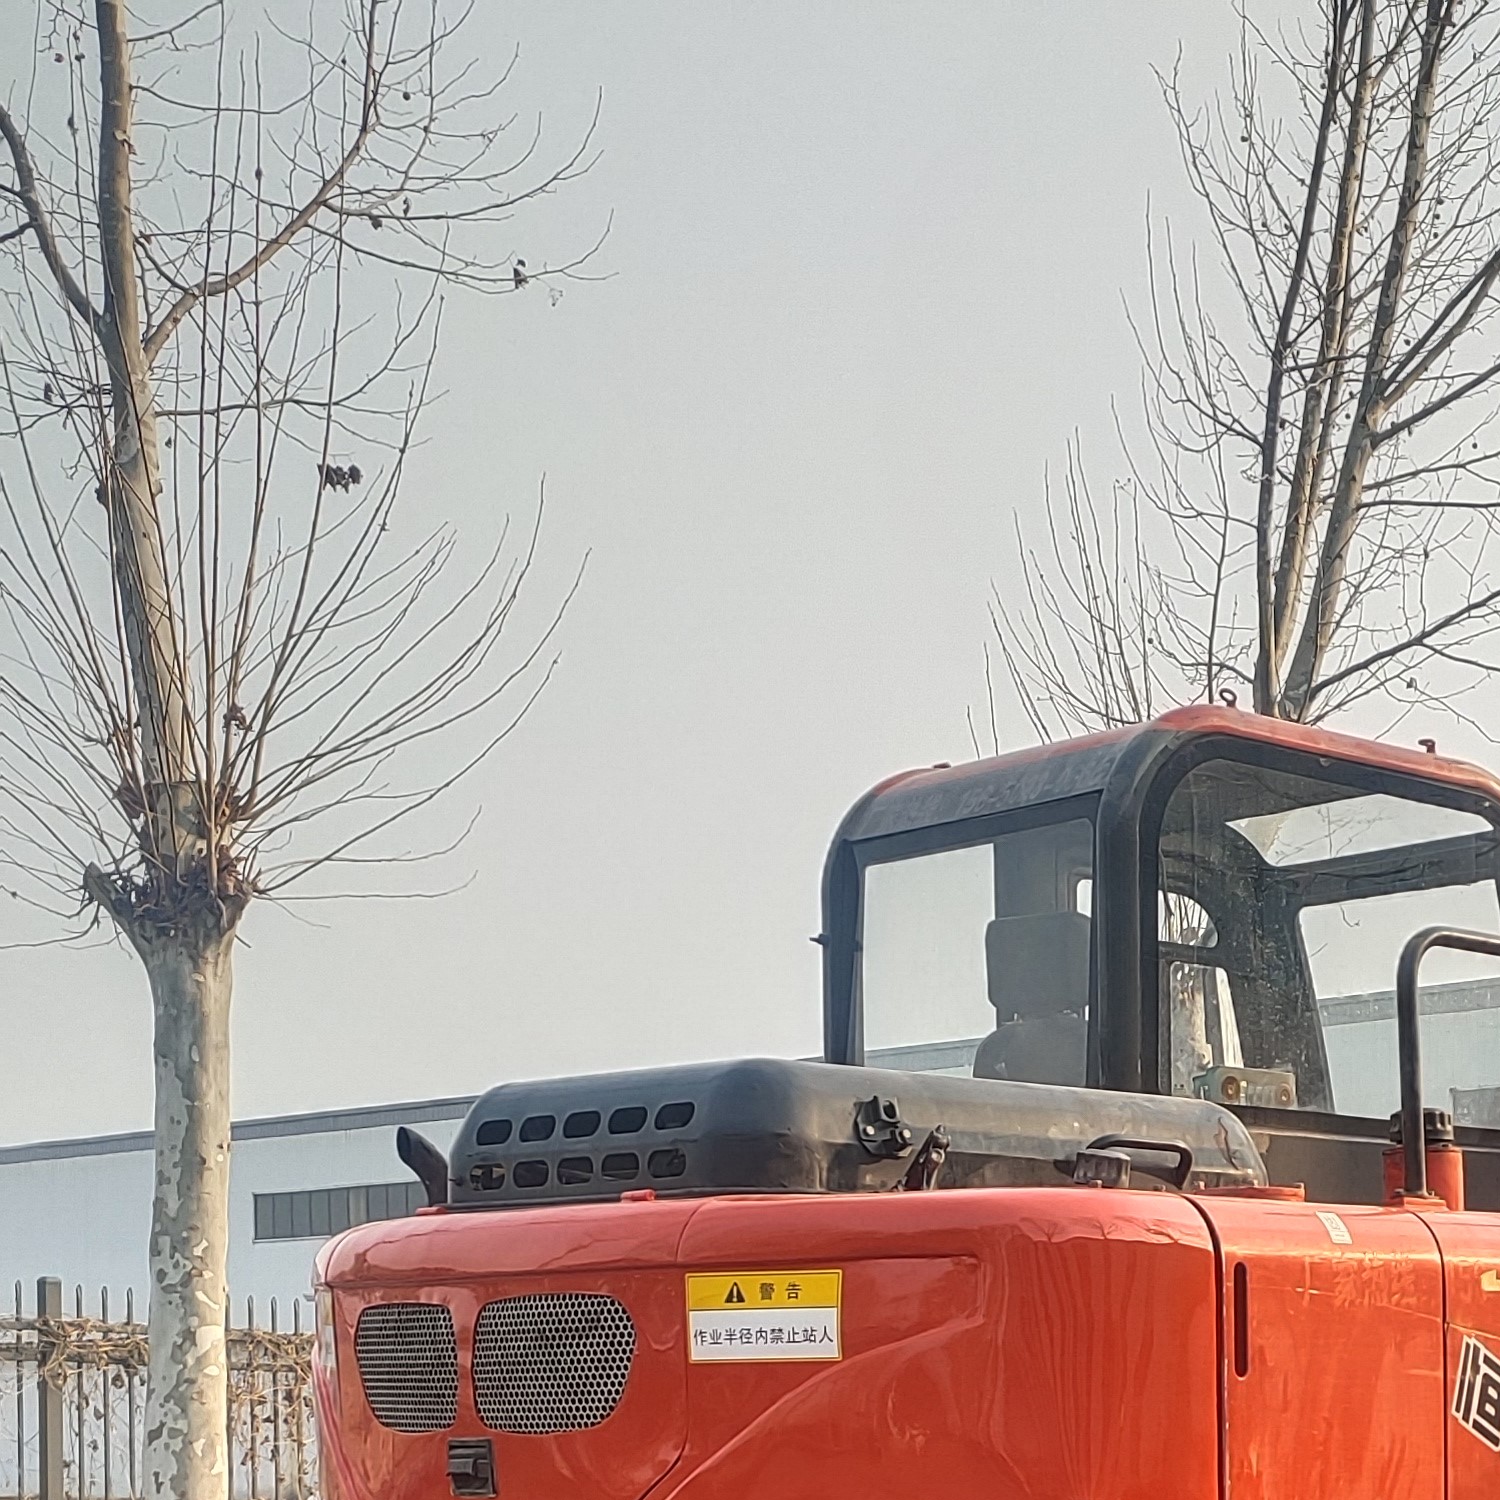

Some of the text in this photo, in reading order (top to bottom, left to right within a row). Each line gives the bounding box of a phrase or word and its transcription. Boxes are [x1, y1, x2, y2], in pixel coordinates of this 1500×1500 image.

[758, 1281, 803, 1301] 警告
[694, 1325, 834, 1345] 作业半径内禁止站人
